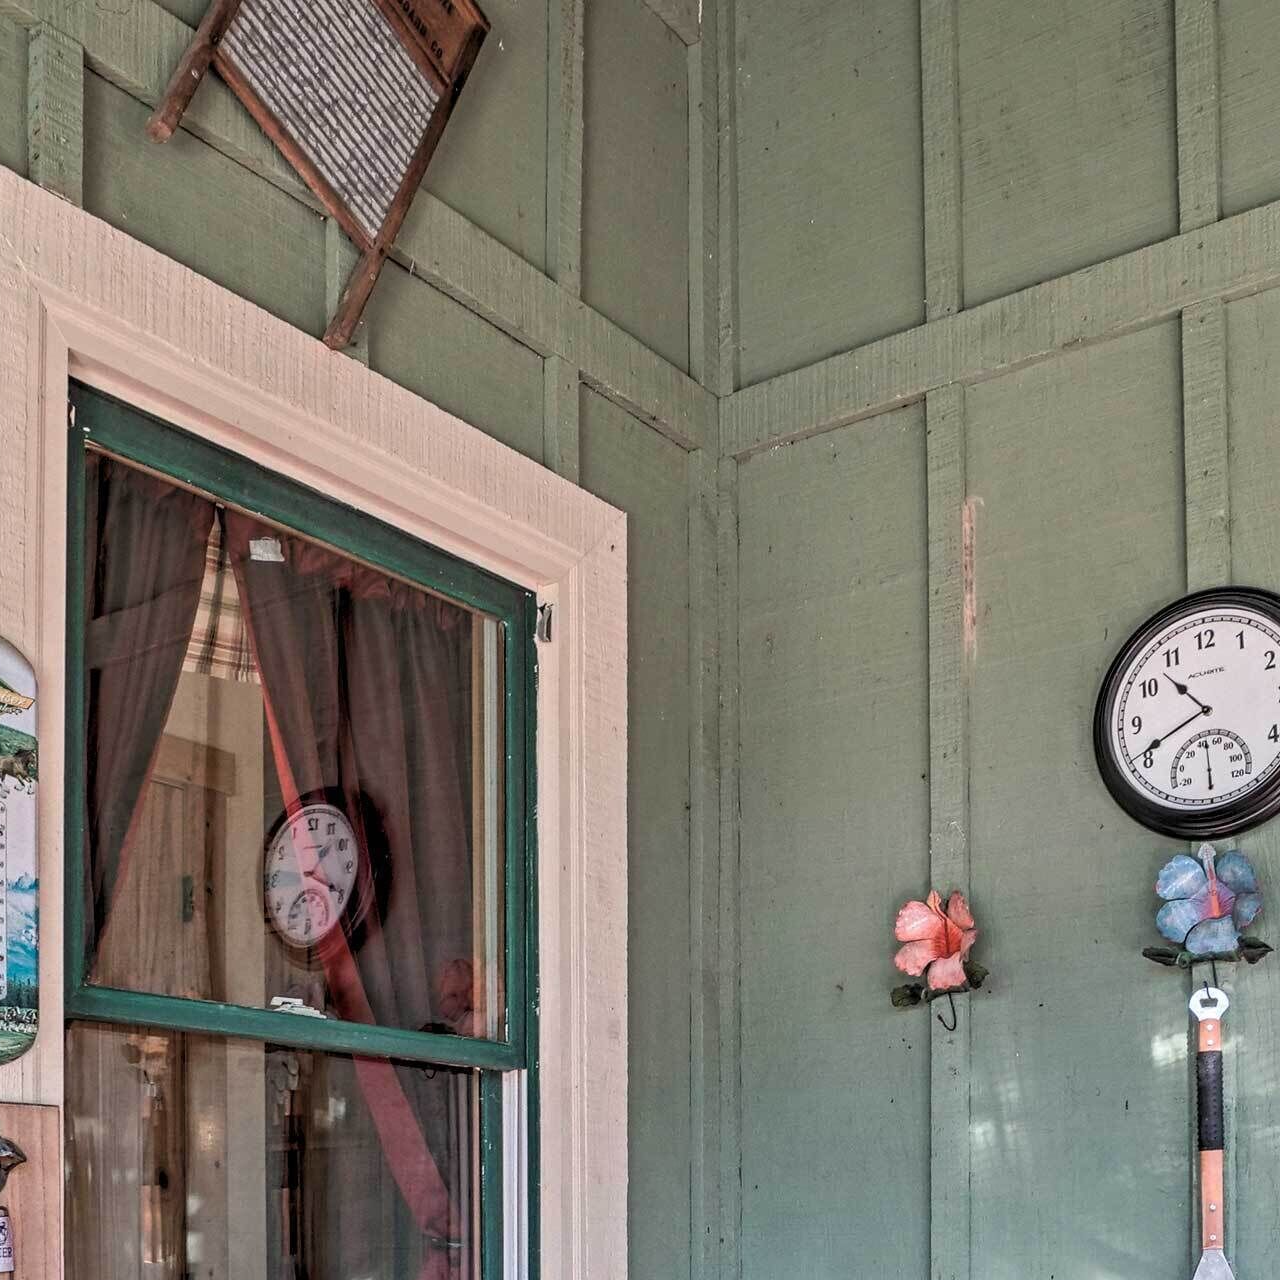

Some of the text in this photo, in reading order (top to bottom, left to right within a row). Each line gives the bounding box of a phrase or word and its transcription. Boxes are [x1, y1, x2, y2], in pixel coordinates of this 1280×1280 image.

[1194, 629, 1216, 650] 12
[1235, 630, 1245, 650] 1
[1162, 646, 1180, 667] 11
[1264, 650, 1277, 671] 2
[1138, 678, 1159, 699] 10
[1131, 716, 1142, 735] 9
[1267, 724, 1280, 743] 4
[1212, 736, 1223, 746] 60
[1223, 741, 1234, 751] 80
[1143, 750, 1154, 769] 8
[1185, 750, 1196, 760] 20
[1229, 753, 1243, 763] 100
[1179, 765, 1185, 773] 0
[1231, 768, 1245, 779] 120
[0, 984, 5, 995] F
